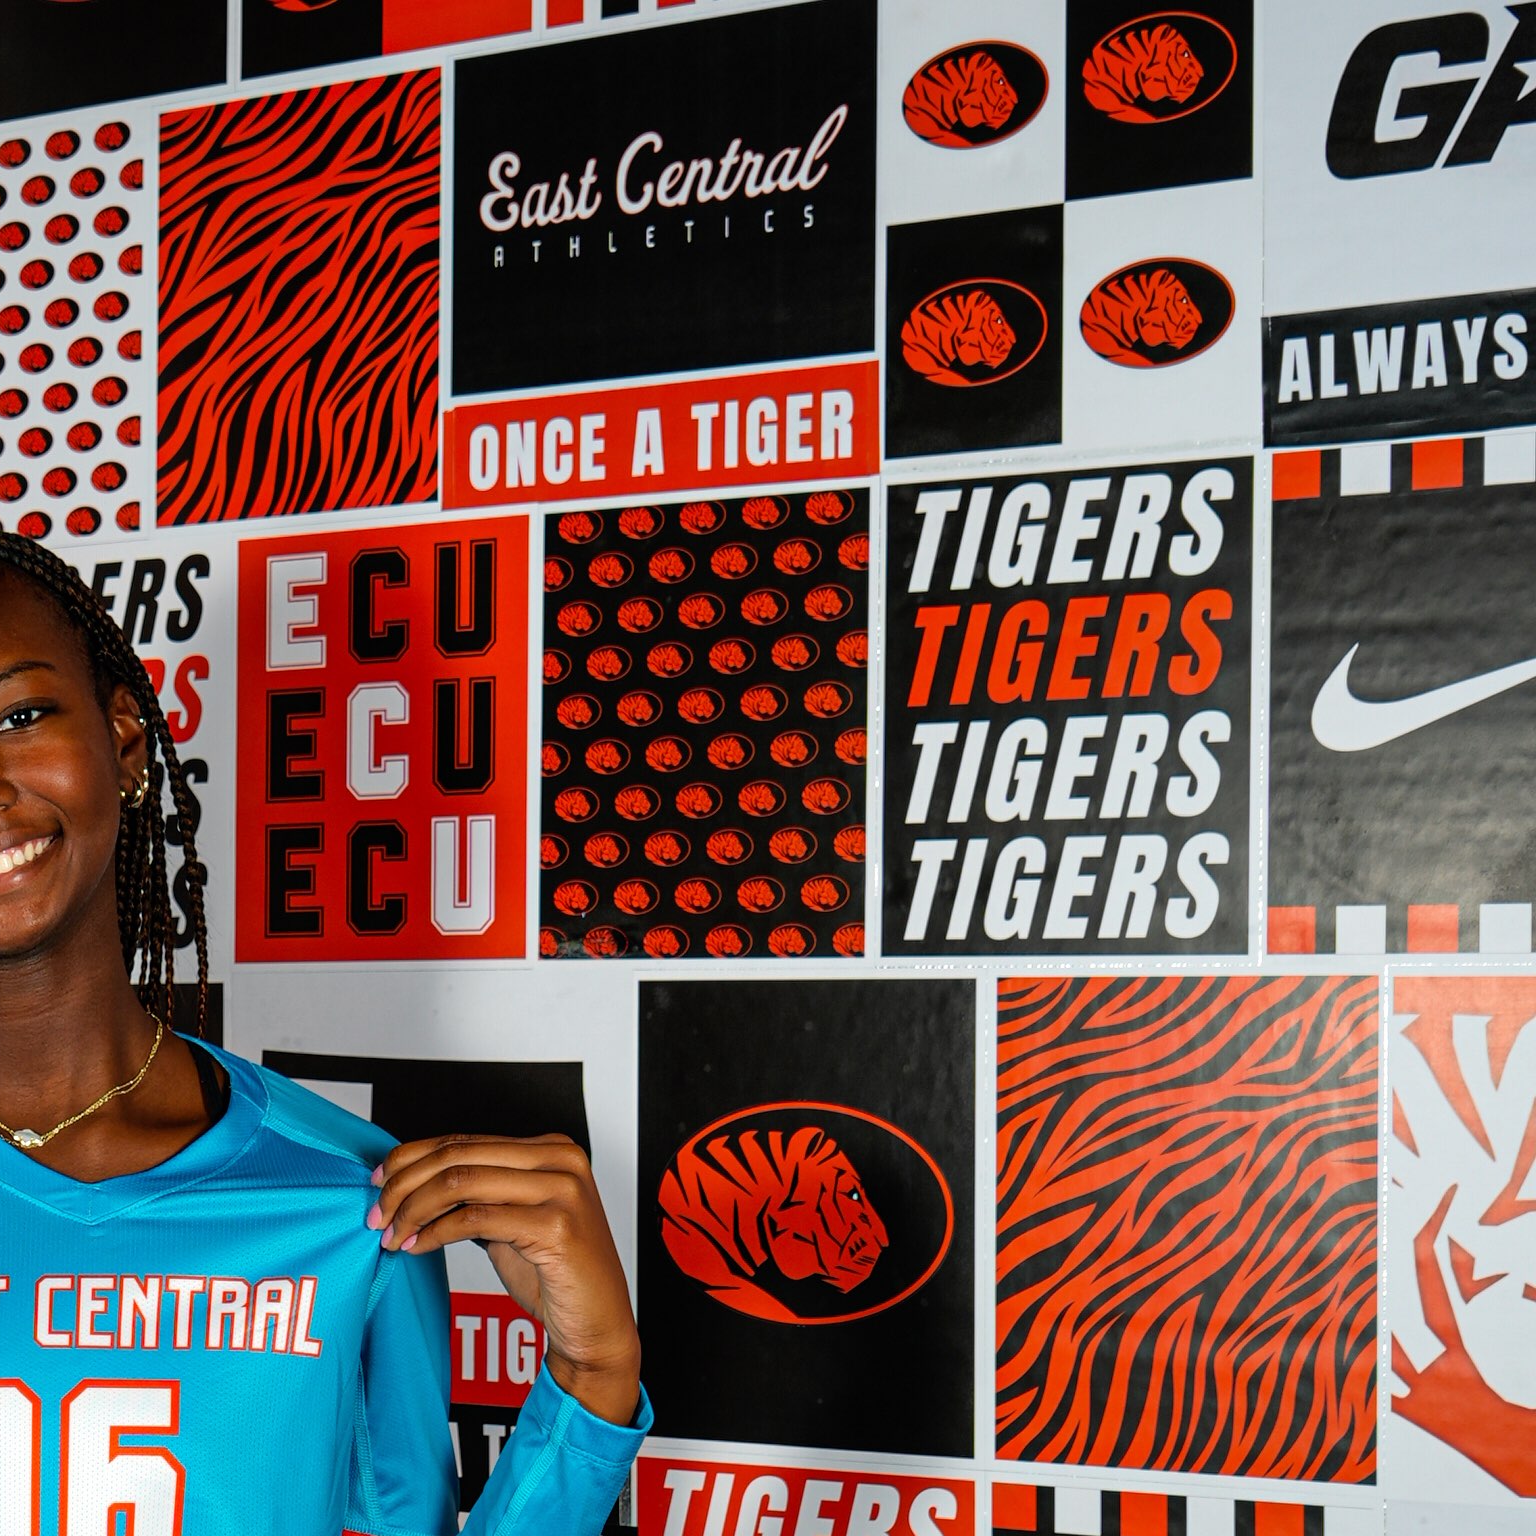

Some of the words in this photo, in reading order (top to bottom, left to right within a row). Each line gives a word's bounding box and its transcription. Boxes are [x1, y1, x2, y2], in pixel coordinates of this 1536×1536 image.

[479, 151, 602, 232] East
[616, 103, 848, 215] Central
[494, 204, 814, 268] ATHLETICS
[1277, 312, 1529, 404] ALWAYS
[468, 413, 606, 491] ONCE
[631, 408, 665, 477] A
[690, 389, 855, 472] TIGER
[906, 468, 1234, 593] TIGERS
[265, 537, 497, 672] ECU
[906, 589, 1233, 707] TIGERS
[265, 678, 496, 800] ECU
[905, 710, 1231, 824] TIGERS
[264, 814, 496, 938] ECU
[903, 832, 1230, 941] TIGERS
[34, 1274, 323, 1358] CENTRAL
[455, 1315, 548, 1385] TIG
